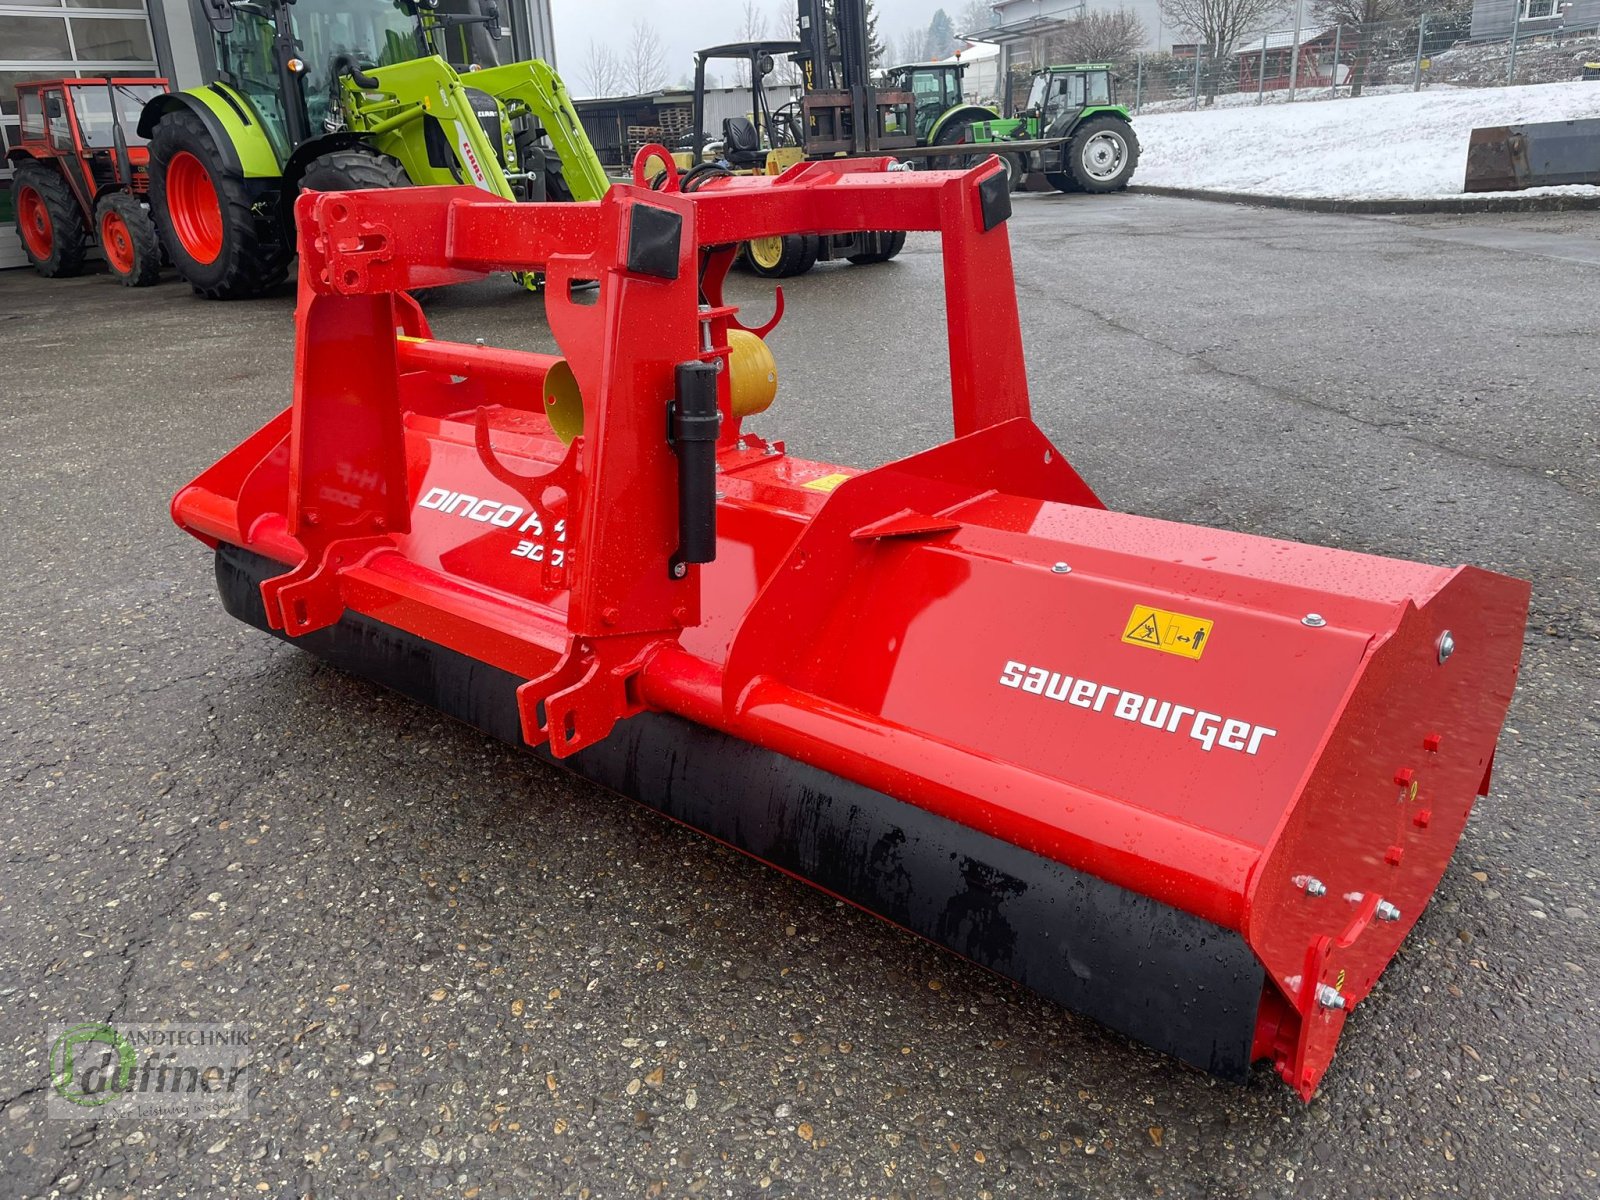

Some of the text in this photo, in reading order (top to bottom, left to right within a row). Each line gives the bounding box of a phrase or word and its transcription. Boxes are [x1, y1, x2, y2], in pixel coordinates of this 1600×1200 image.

[462, 142, 484, 182] CLAAS
[418, 487, 524, 528] DINGO
[510, 539, 564, 568] 300
